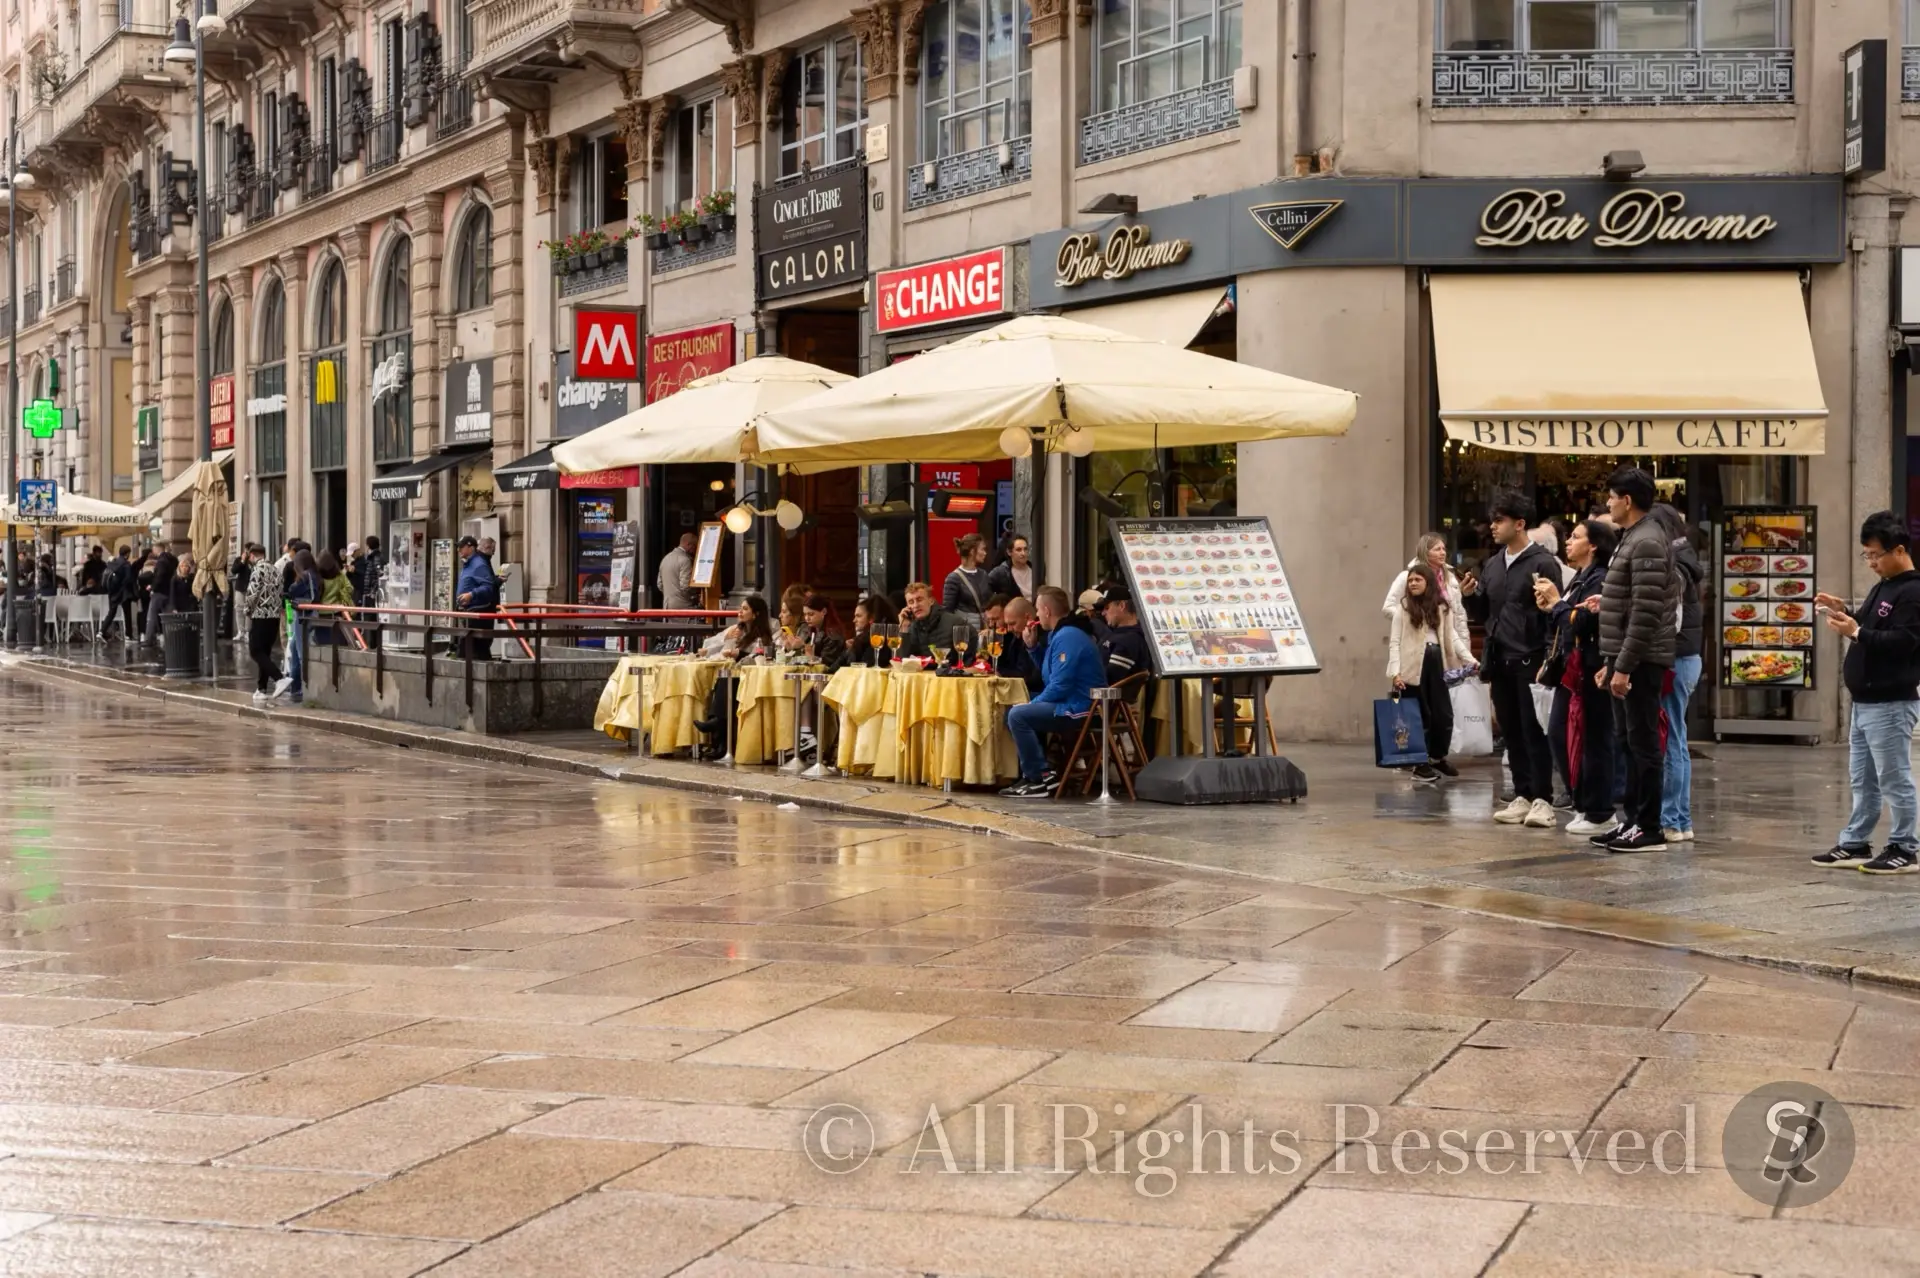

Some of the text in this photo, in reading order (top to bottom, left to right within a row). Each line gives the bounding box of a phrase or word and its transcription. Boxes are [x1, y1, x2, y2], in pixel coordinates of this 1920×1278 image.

[1847, 143, 1861, 167] BAR
[808, 187, 842, 215] TERRE
[874, 194, 882, 209] 17
[1267, 210, 1308, 226] Cellini
[1475, 188, 1778, 247] Bar Duomo
[769, 241, 855, 288] CALORI
[1055, 225, 1187, 287] Bar Duomo
[896, 261, 1000, 318] CHANGE
[580, 323, 635, 365] M
[654, 332, 723, 363] RESTAURANT
[558, 376, 607, 410] change
[455, 412, 490, 432] SOUVENIR
[1469, 420, 1653, 449] BISTROT
[936, 471, 962, 487] WE
[12, 514, 69, 522] GELATERIA
[76, 514, 139, 524] RISTORANTE
